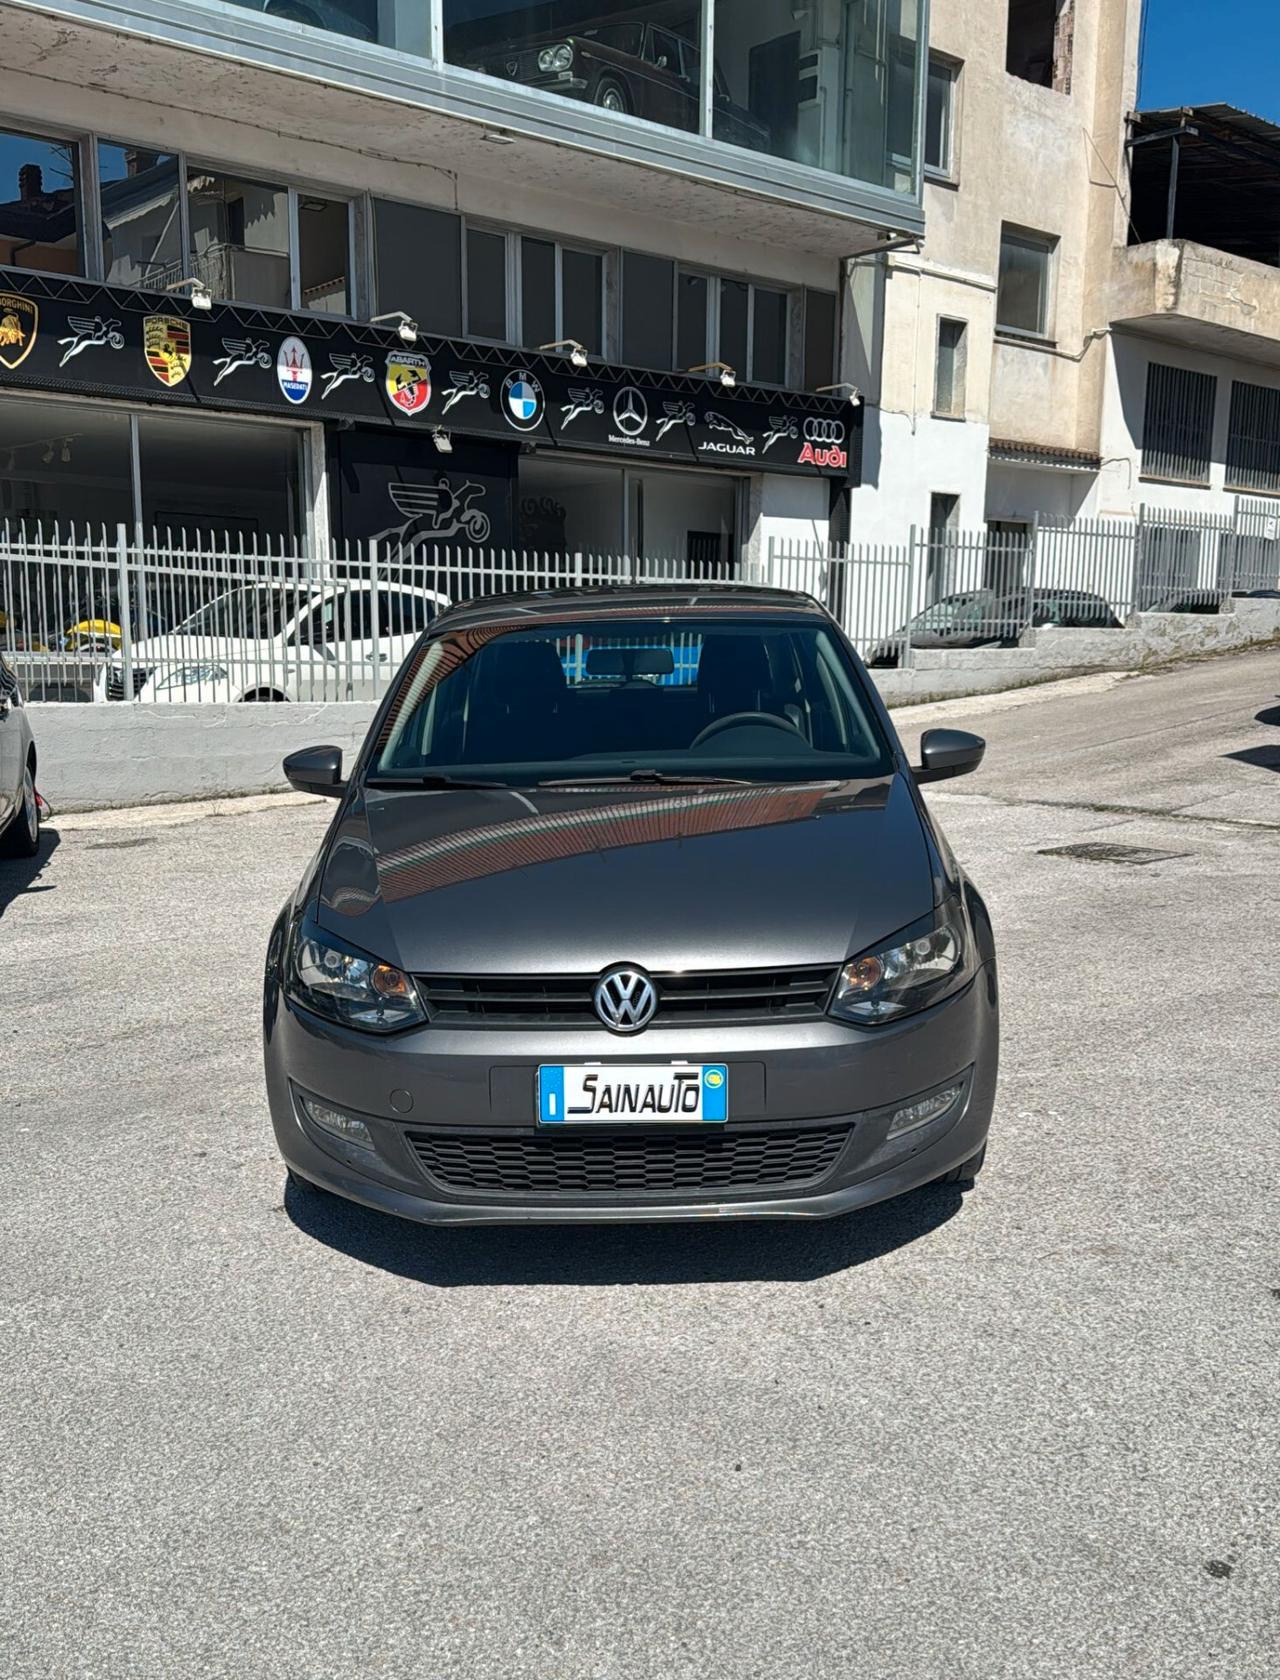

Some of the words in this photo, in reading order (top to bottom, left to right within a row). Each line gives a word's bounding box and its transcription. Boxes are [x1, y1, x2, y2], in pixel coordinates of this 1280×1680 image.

[145, 316, 188, 329] PORSCHE
[390, 355, 426, 366] ABARTH
[284, 382, 307, 391] MASERATI
[505, 372, 540, 393] BMW
[608, 434, 650, 447] Mercedes-Benz
[698, 442, 756, 456] JAGUAR
[798, 442, 847, 468] Audi
[567, 1072, 700, 1114] SAINAUTO
